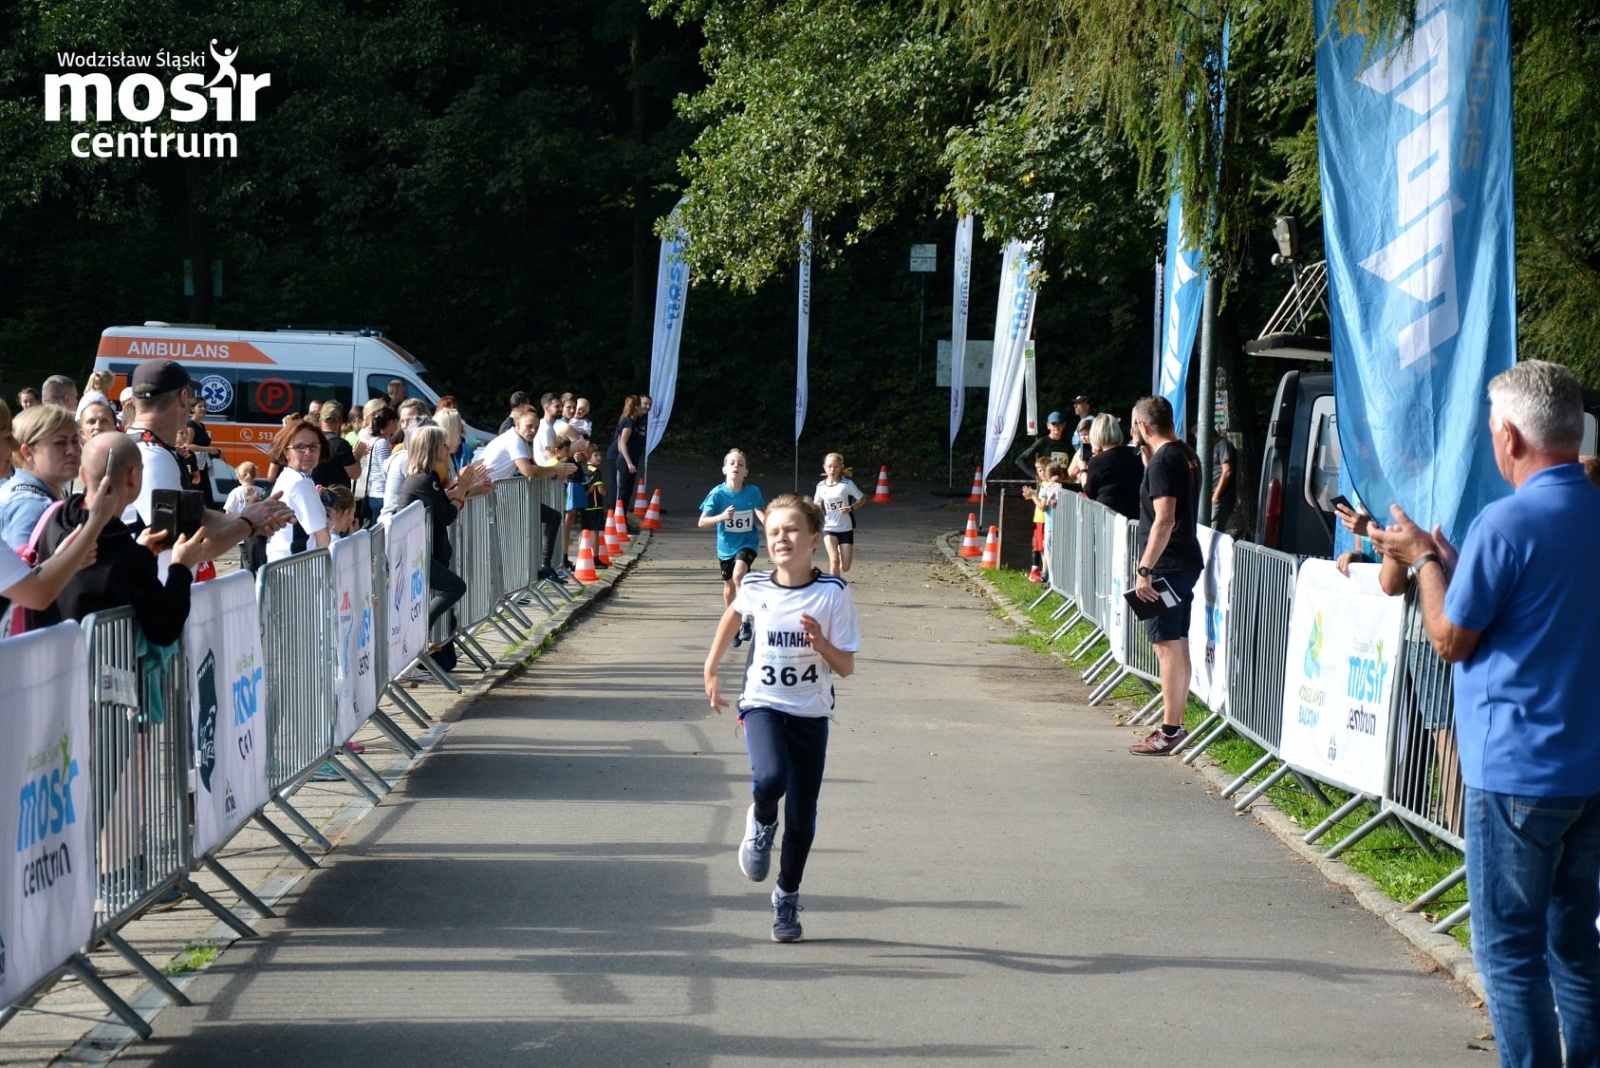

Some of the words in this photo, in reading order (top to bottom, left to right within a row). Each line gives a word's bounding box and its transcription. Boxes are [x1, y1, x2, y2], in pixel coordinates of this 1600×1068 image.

[127, 341, 230, 358] AMBULANS
[726, 517, 751, 529] 361
[761, 664, 819, 687] 364
